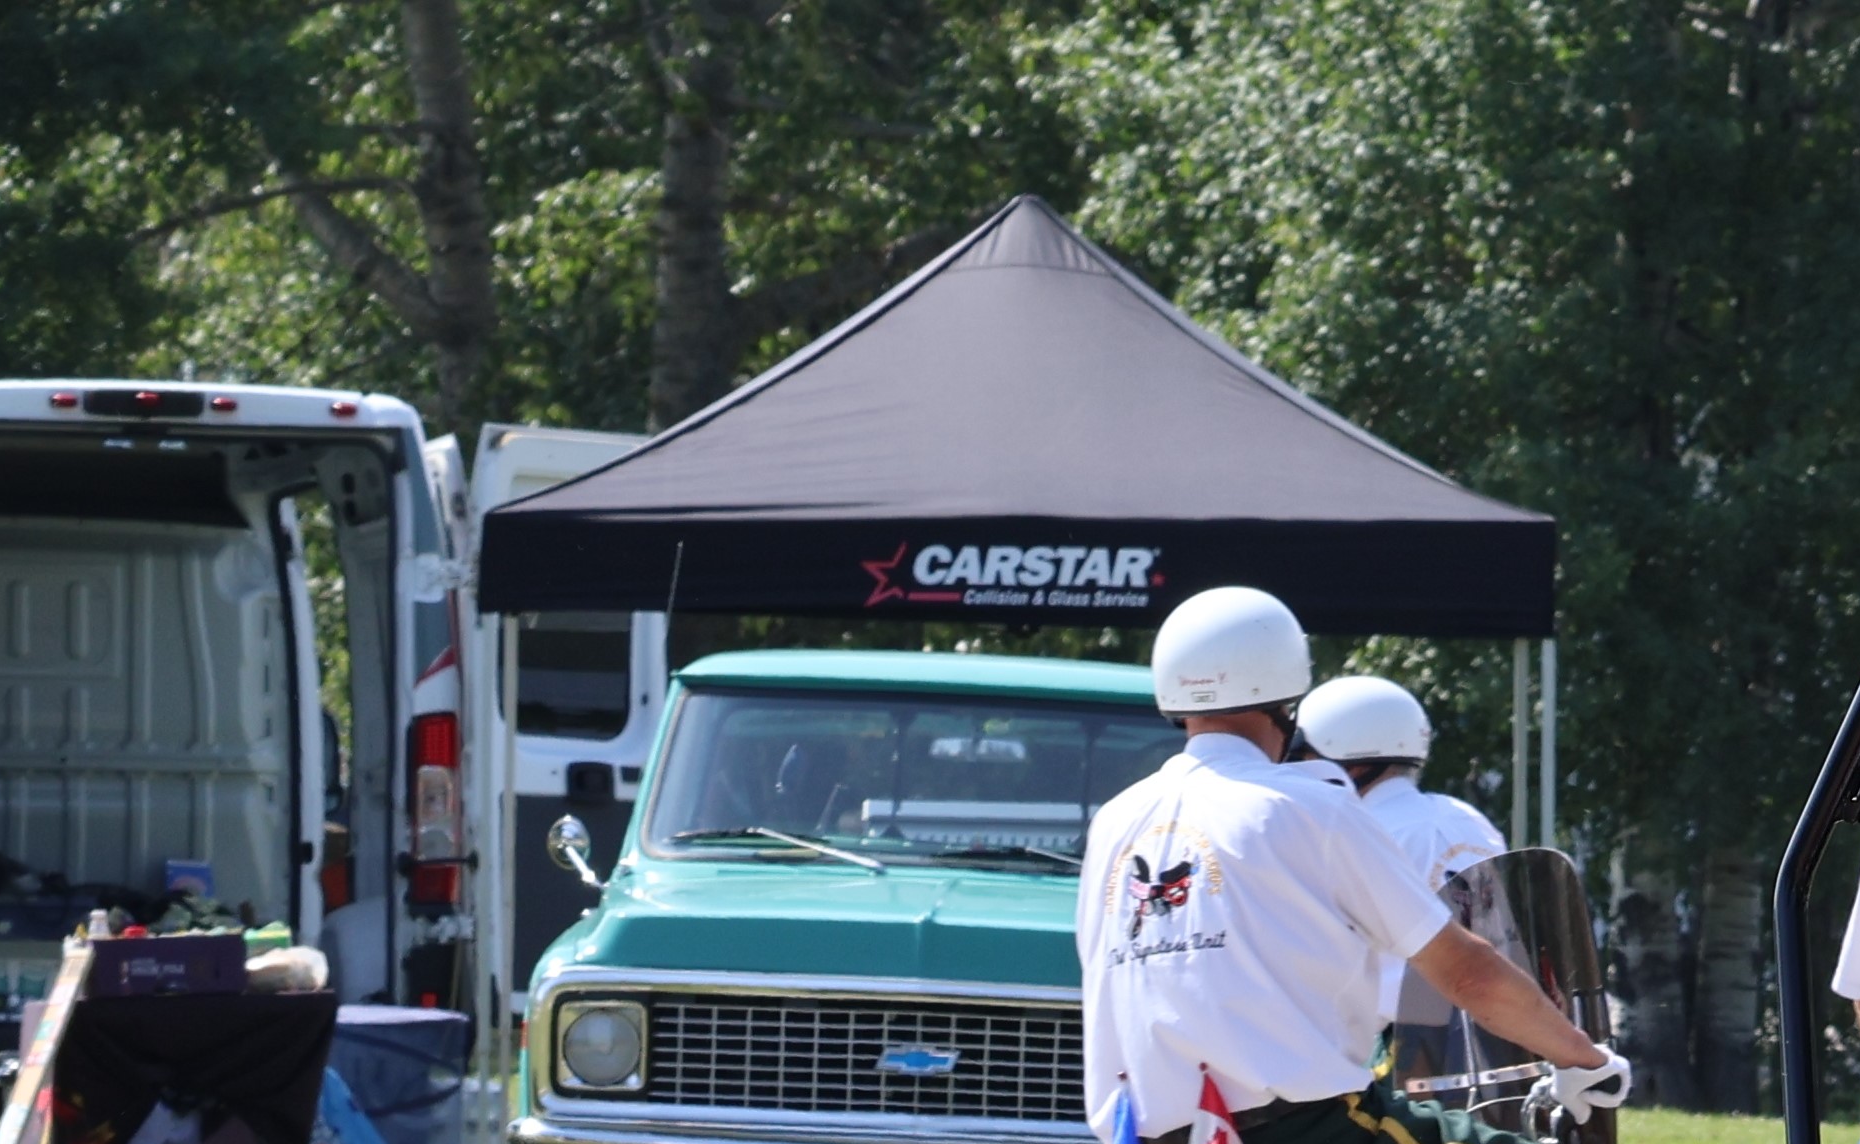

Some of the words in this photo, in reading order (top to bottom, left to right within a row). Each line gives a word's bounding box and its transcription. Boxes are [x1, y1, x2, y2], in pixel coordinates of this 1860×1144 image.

[912, 544, 1154, 587] CARSTAR
[963, 589, 1030, 606] Collision
[1032, 590, 1043, 605] &
[1047, 590, 1090, 607] Glass
[1091, 590, 1150, 607] Service
